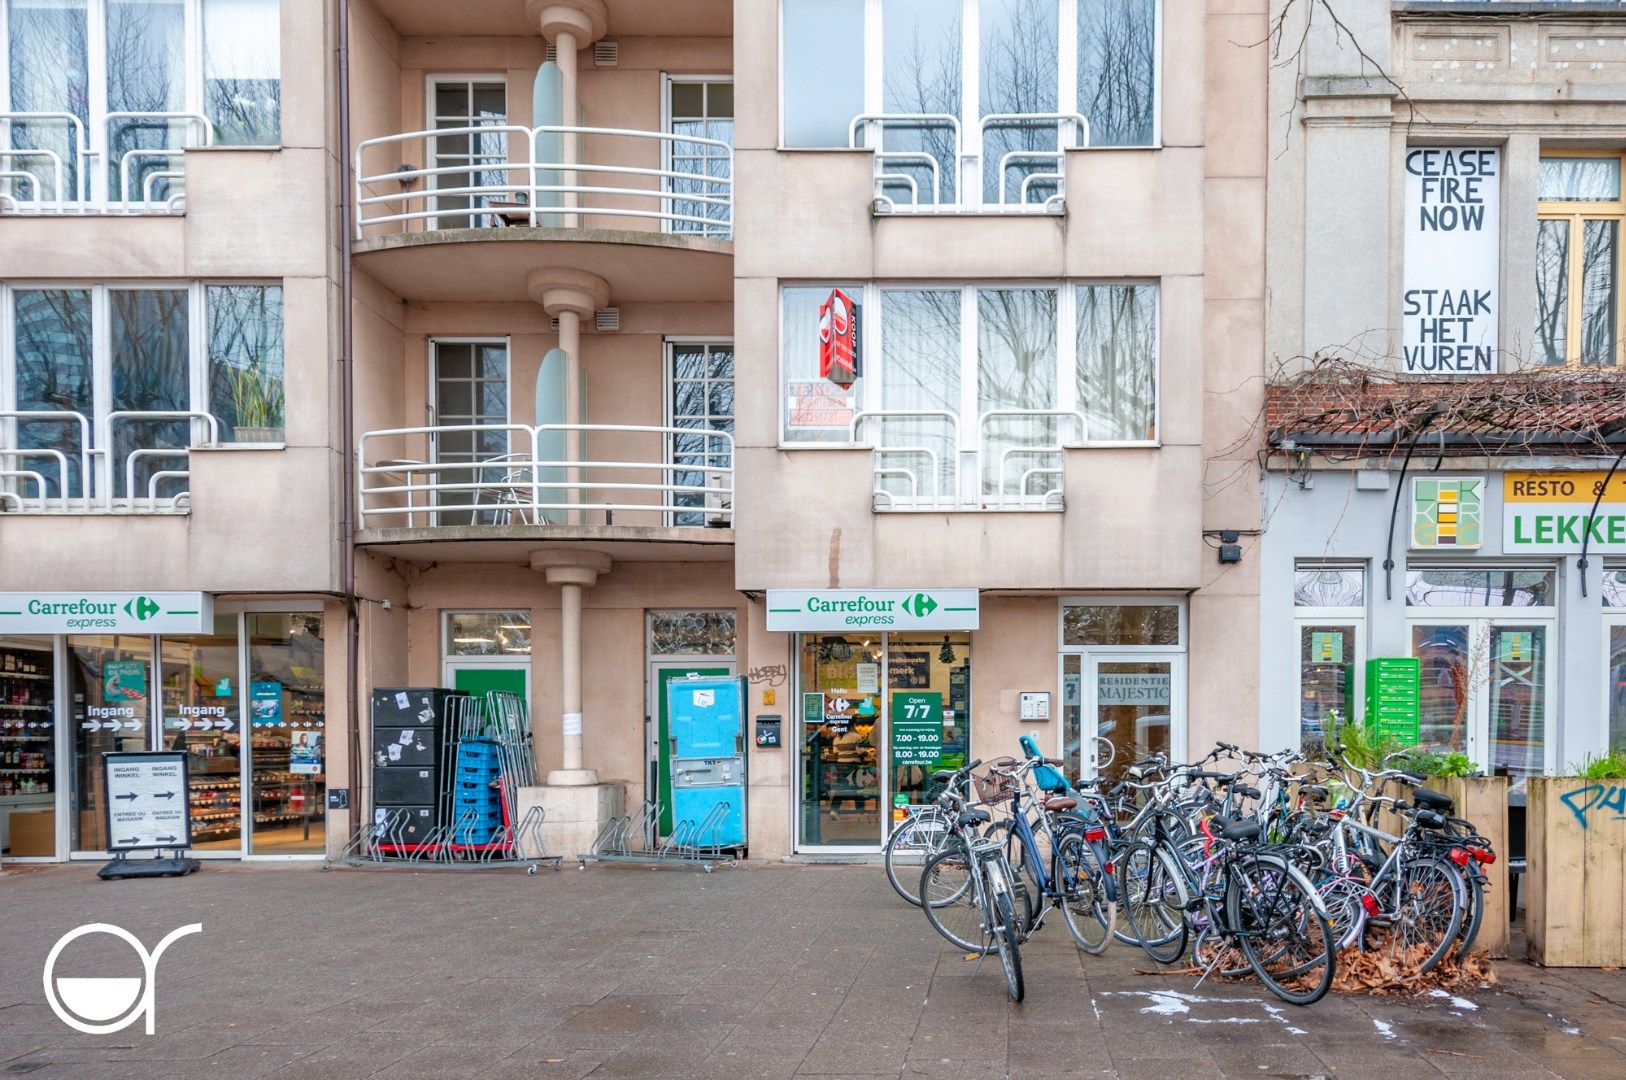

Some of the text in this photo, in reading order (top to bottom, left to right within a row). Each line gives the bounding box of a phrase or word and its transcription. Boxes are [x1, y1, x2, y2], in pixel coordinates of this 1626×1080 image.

[1405, 150, 1495, 176] CEASE
[1422, 177, 1483, 203] FIRE
[1420, 205, 1485, 231] NOW
[1403, 289, 1491, 316] STAAK
[1420, 317, 1474, 343] HET
[1403, 345, 1491, 371] VUREN
[1513, 480, 1606, 496] RESTO &
[28, 599, 117, 614] Carrefour
[807, 595, 895, 612] Carrefour
[67, 617, 116, 630] express
[845, 614, 894, 627] express
[1100, 677, 1169, 685] RESIDENTIE
[1066, 683, 1077, 700] 7
[1099, 687, 1169, 702] MAJESTIC
[88, 705, 135, 718] Ingang
[179, 704, 226, 717] Ingang
[904, 704, 931, 719] 7/7
[895, 734, 913, 742] 7.00
[917, 734, 939, 742] 19.00
[895, 750, 913, 758] 8.00
[918, 750, 939, 758] 19.00
